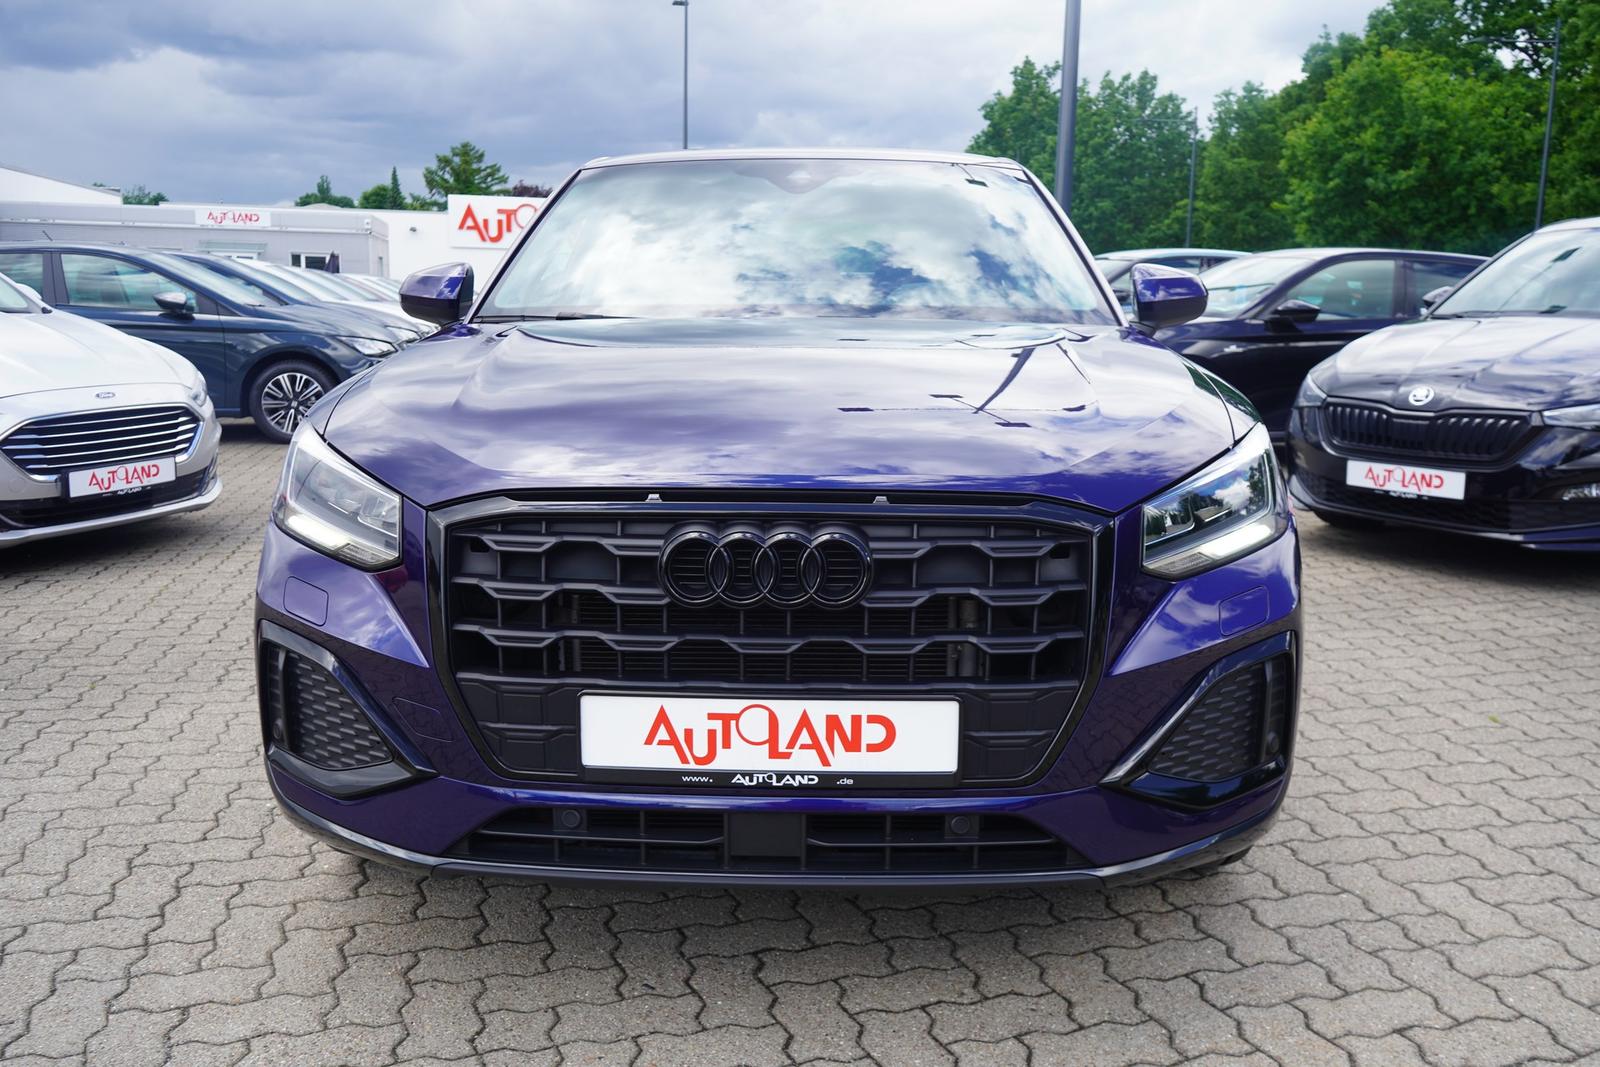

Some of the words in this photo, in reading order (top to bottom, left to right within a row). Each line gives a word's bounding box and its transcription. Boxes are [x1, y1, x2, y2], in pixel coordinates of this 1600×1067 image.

[88, 464, 160, 491] AUTOLAND
[1364, 466, 1444, 492] AUTOLAND
[643, 704, 897, 767] AUTOLAND
[681, 775, 713, 783] www.
[731, 772, 819, 787] AUTOLAND
[836, 777, 854, 785] .de
